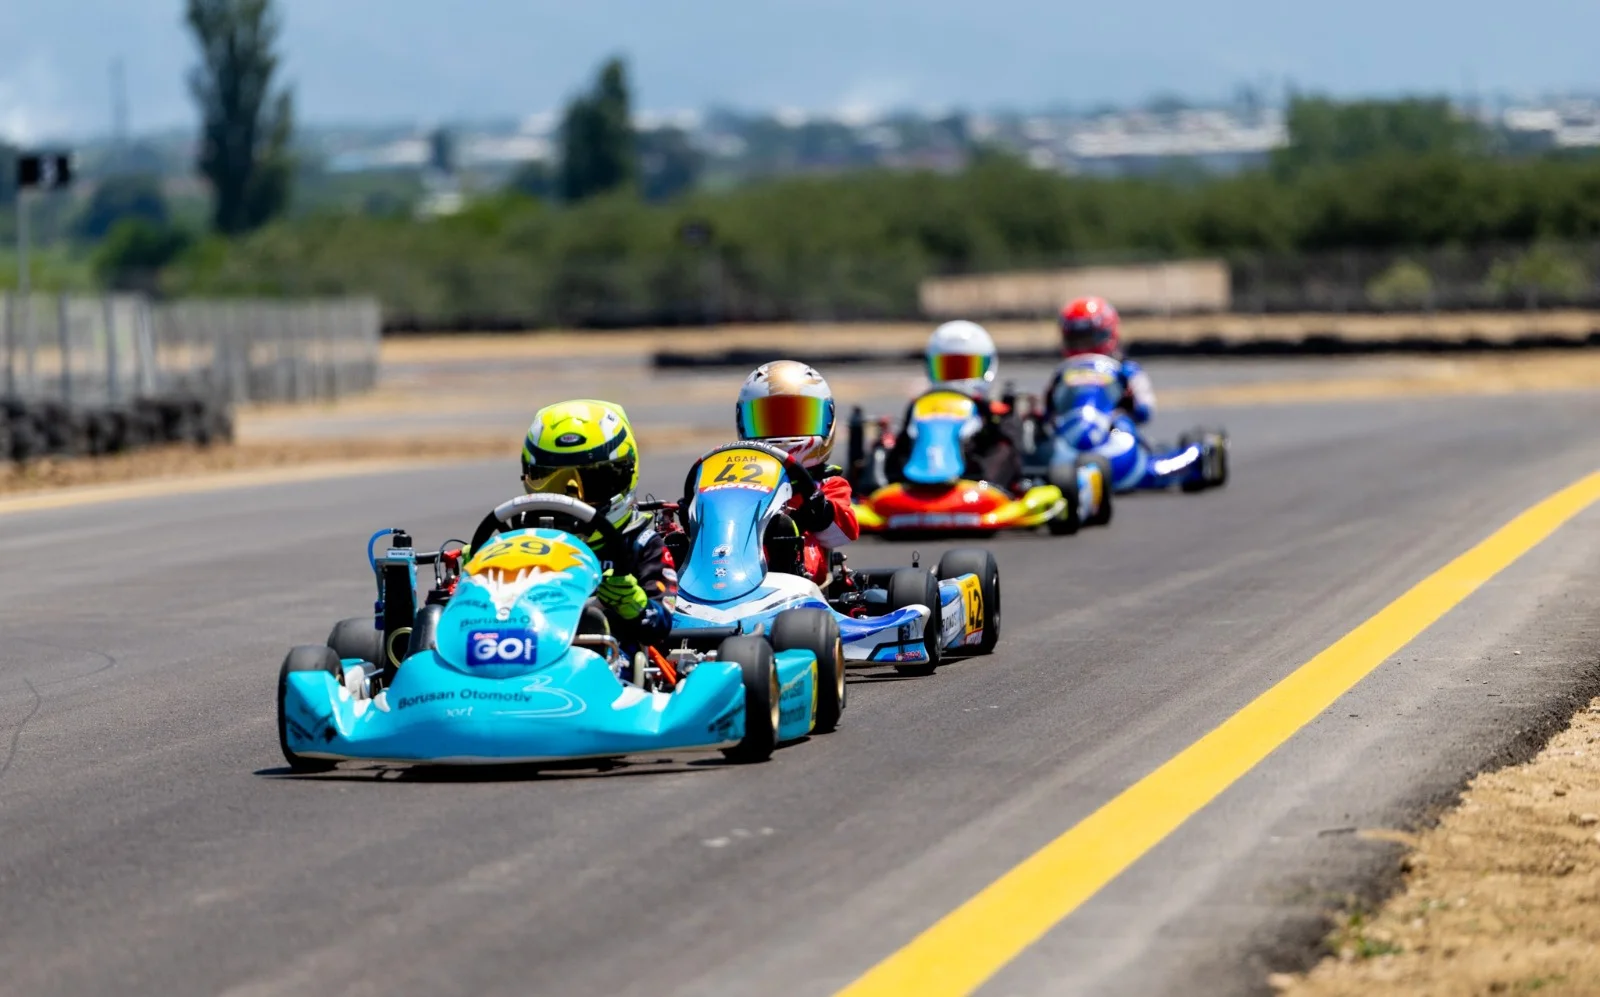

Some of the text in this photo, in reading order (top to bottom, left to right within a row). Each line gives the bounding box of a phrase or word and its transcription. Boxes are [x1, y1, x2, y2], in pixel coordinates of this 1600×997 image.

[726, 455, 758, 463] AGAH
[713, 463, 764, 484] 42
[480, 540, 551, 562] 29
[967, 588, 984, 631] 42
[398, 688, 532, 710] Borusan Otomotiv
